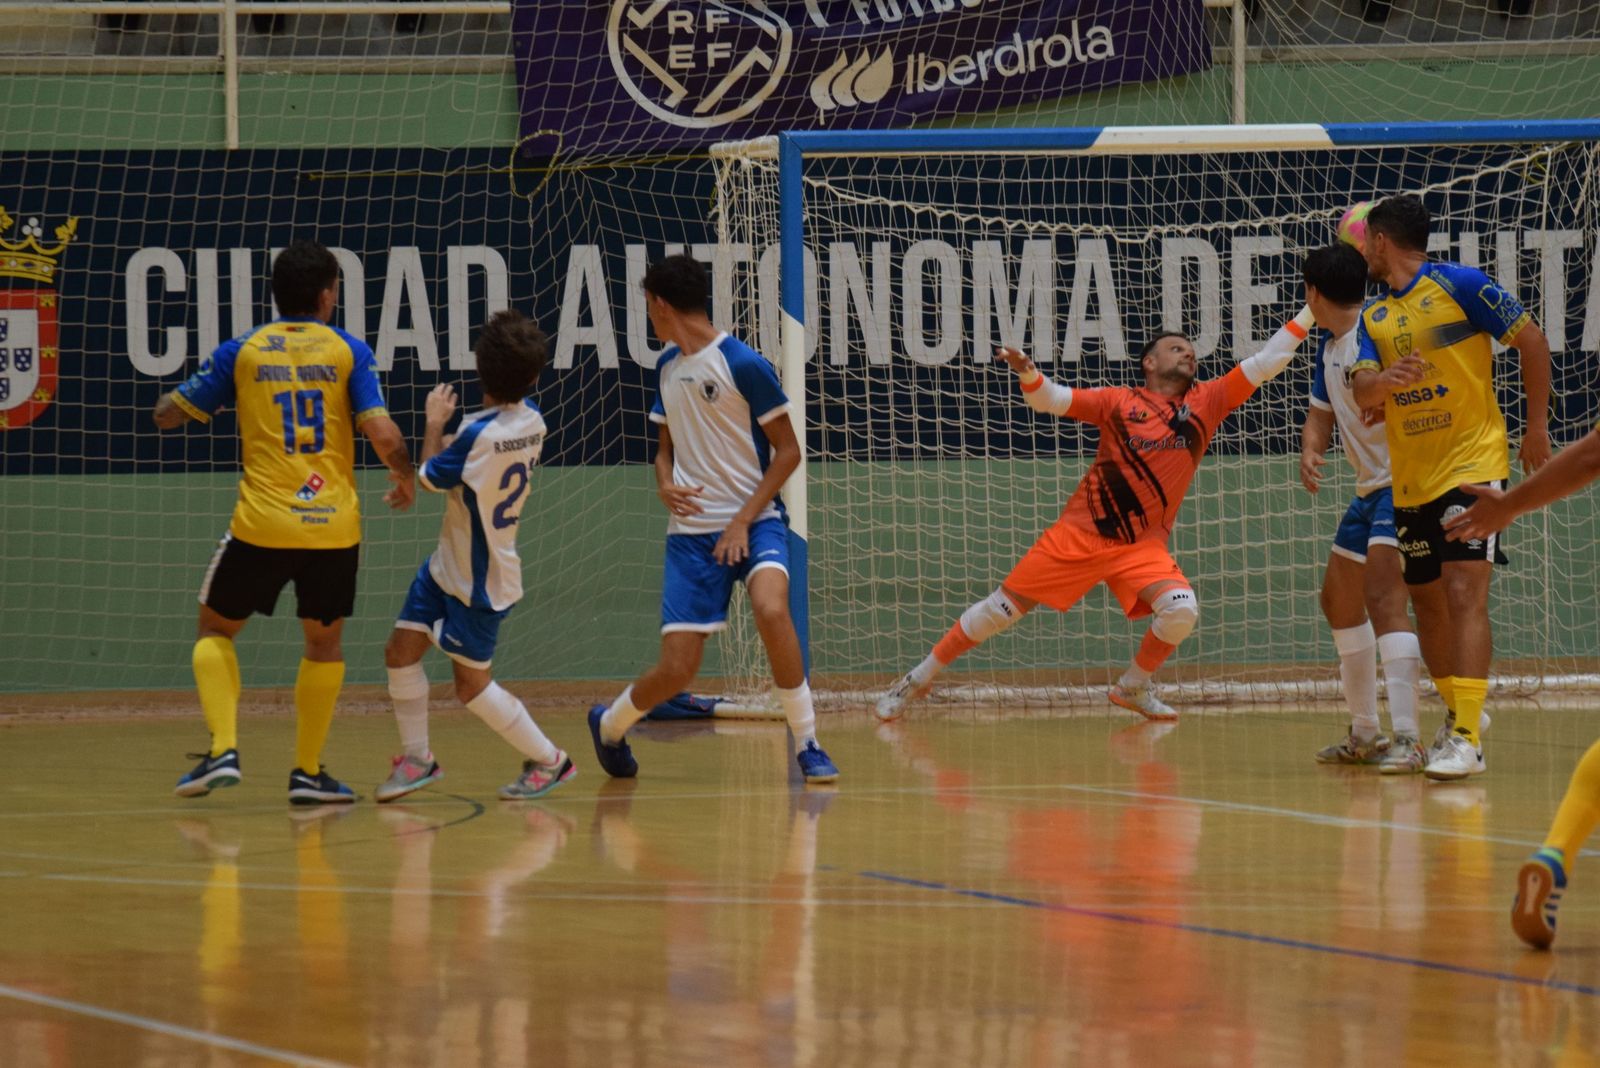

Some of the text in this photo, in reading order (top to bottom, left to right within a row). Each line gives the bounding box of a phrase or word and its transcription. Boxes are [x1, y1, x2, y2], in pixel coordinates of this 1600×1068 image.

[906, 19, 1116, 95] Iberdrola
[1161, 234, 1286, 361] DE
[273, 389, 325, 455] 19
